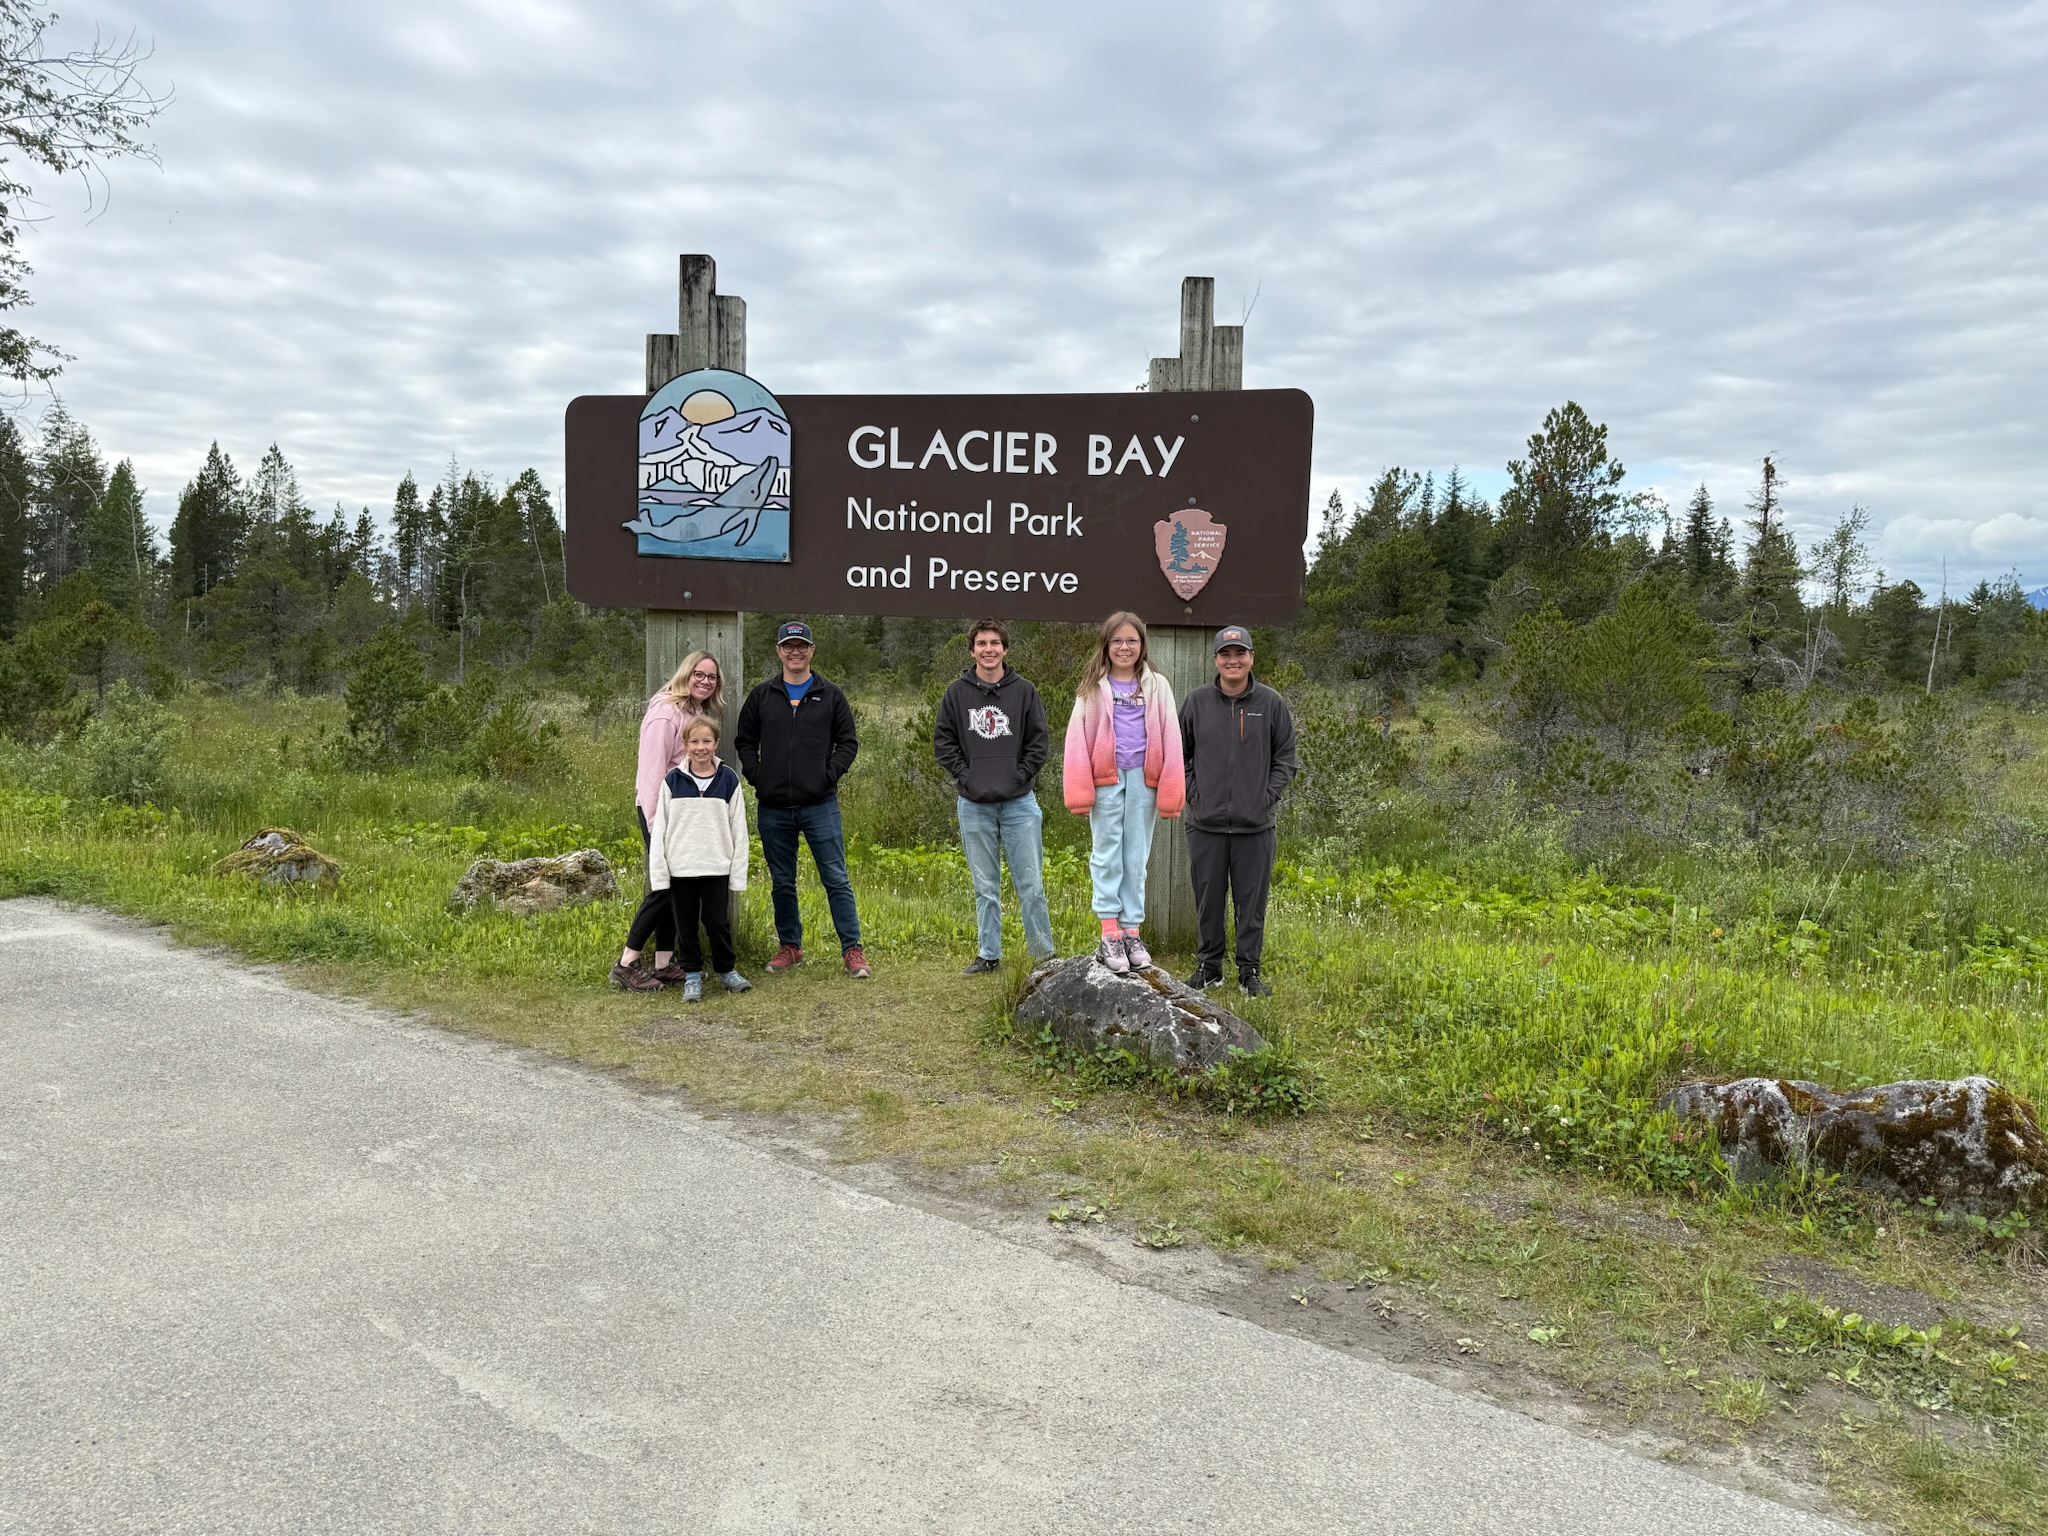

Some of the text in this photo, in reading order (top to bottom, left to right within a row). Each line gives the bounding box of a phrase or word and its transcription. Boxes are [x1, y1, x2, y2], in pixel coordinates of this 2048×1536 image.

[847, 425, 1186, 479] GLACIER BAY
[847, 496, 1084, 538] National Park
[847, 554, 1080, 595] and Preserve
